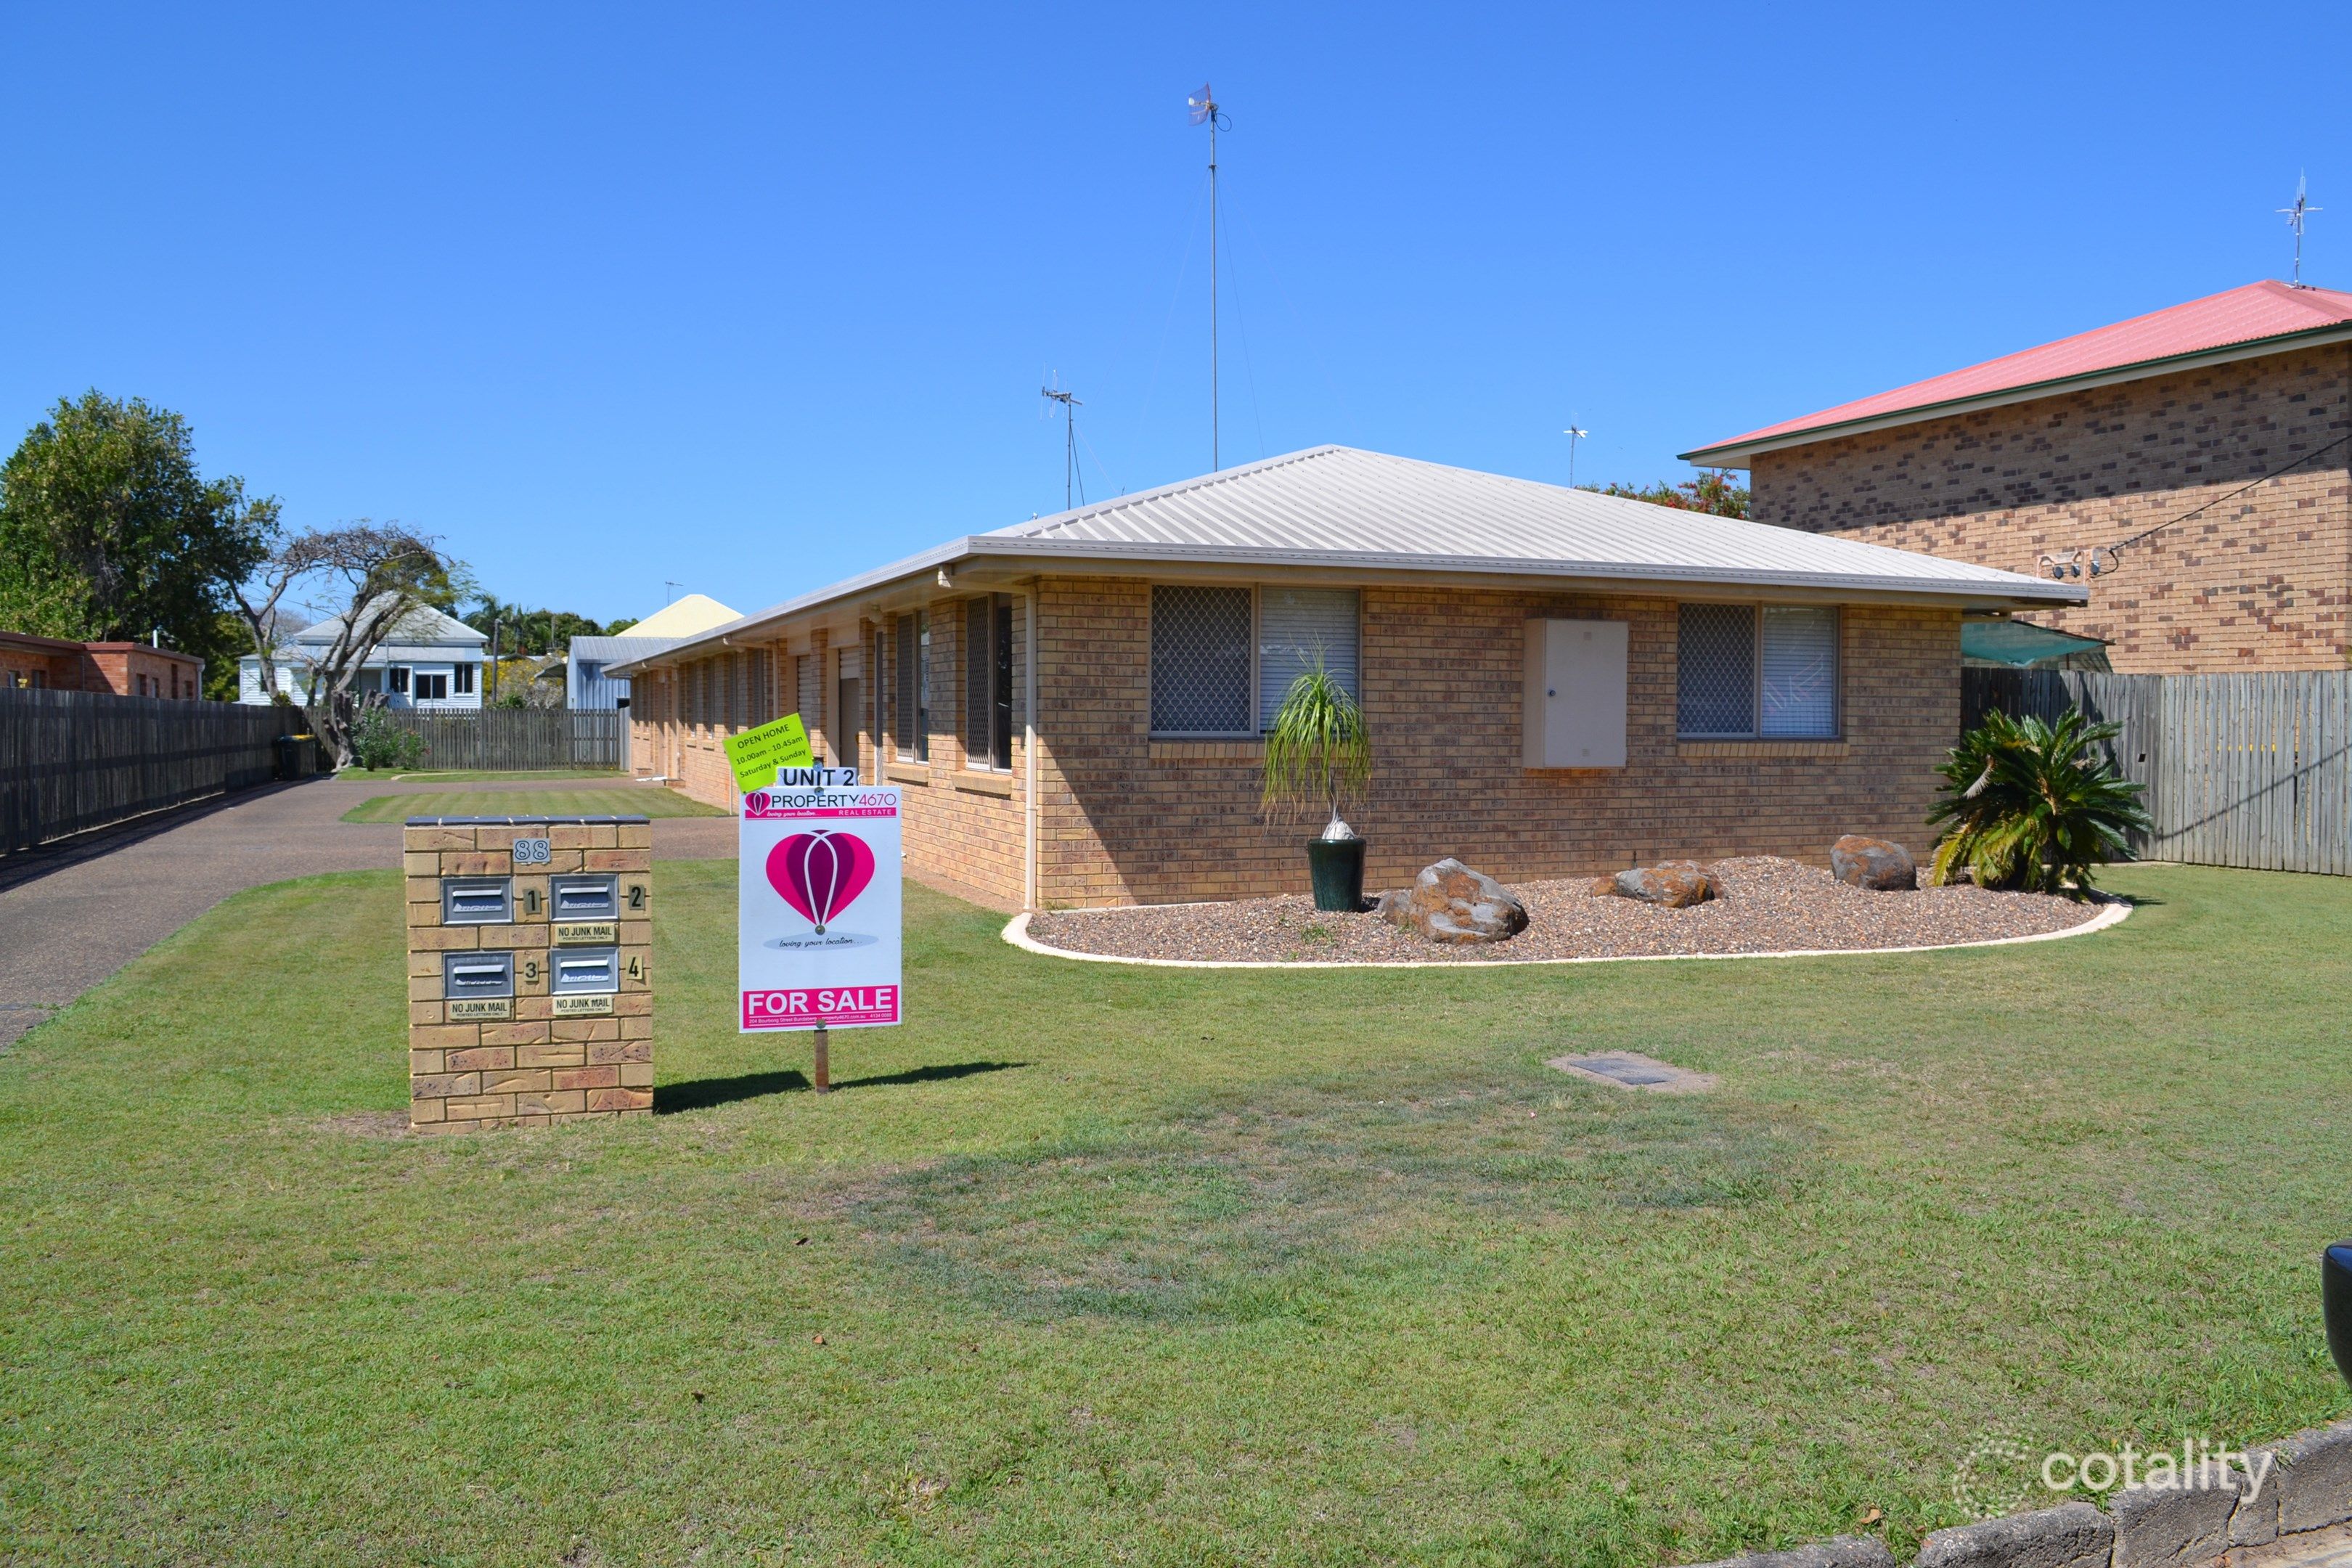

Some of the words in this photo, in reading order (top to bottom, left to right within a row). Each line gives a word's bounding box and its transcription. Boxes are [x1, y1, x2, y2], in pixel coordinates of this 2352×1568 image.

[737, 735, 761, 749] OPEN
[763, 724, 790, 740] HOME
[736, 750, 767, 765] 10.00am
[772, 735, 803, 751] 10.45am
[740, 761, 771, 778] Saturday
[780, 749, 807, 763] Sunday
[783, 769, 836, 786] UNIT
[843, 769, 854, 786] 2
[515, 840, 549, 860] 88
[528, 890, 536, 912] 1
[632, 886, 641, 907] 2
[558, 927, 569, 936] NO
[571, 926, 592, 936] JUNK
[594, 926, 612, 936] MAIL
[525, 962, 537, 979] 3
[629, 957, 639, 977] 4
[452, 1003, 463, 1013] NO
[465, 1003, 486, 1013] JUNK
[488, 1003, 507, 1012] MAIL
[556, 1000, 567, 1008] NO
[569, 999, 589, 1008] JUNK
[592, 998, 610, 1007] MAIL
[748, 992, 809, 1016] FOR
[817, 988, 892, 1013] SALE
